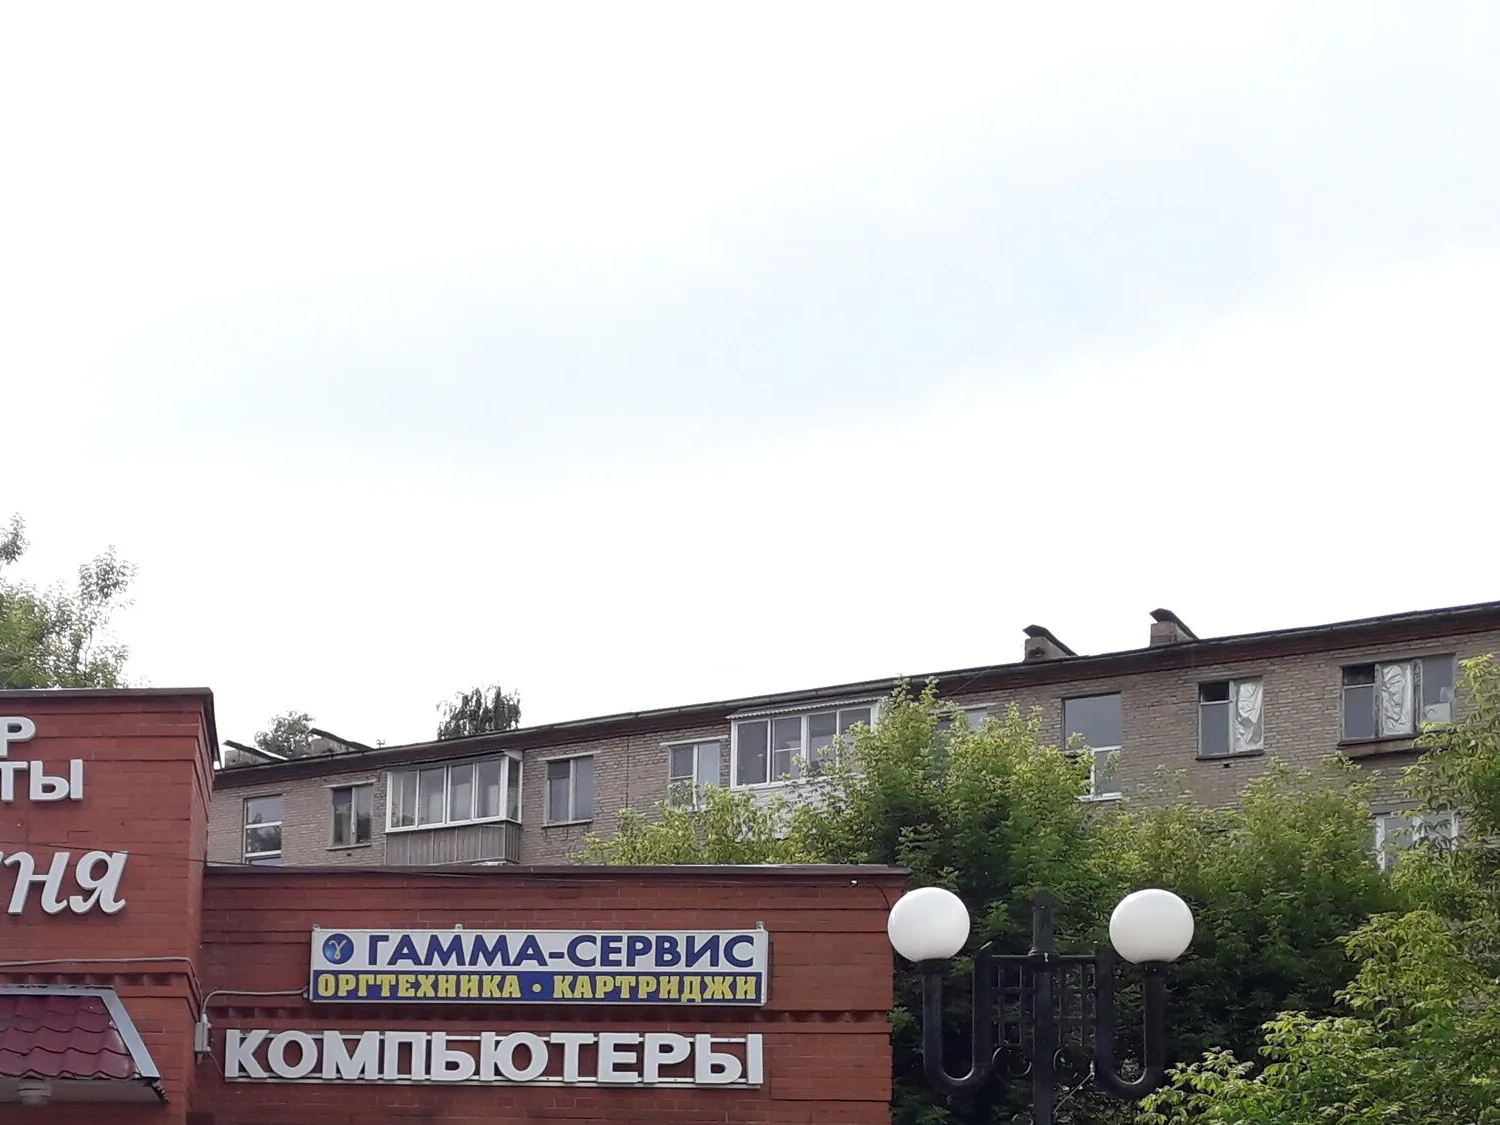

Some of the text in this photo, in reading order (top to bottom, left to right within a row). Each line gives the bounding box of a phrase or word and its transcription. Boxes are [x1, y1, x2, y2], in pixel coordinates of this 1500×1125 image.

[367, 934, 755, 968] ГАММА-СЕРВИС
[316, 973, 757, 1003] ОРГТЕХНИКА КАРТРИДЖИ
[225, 1029, 764, 1085] КОМПЬЮТЕРЫ
